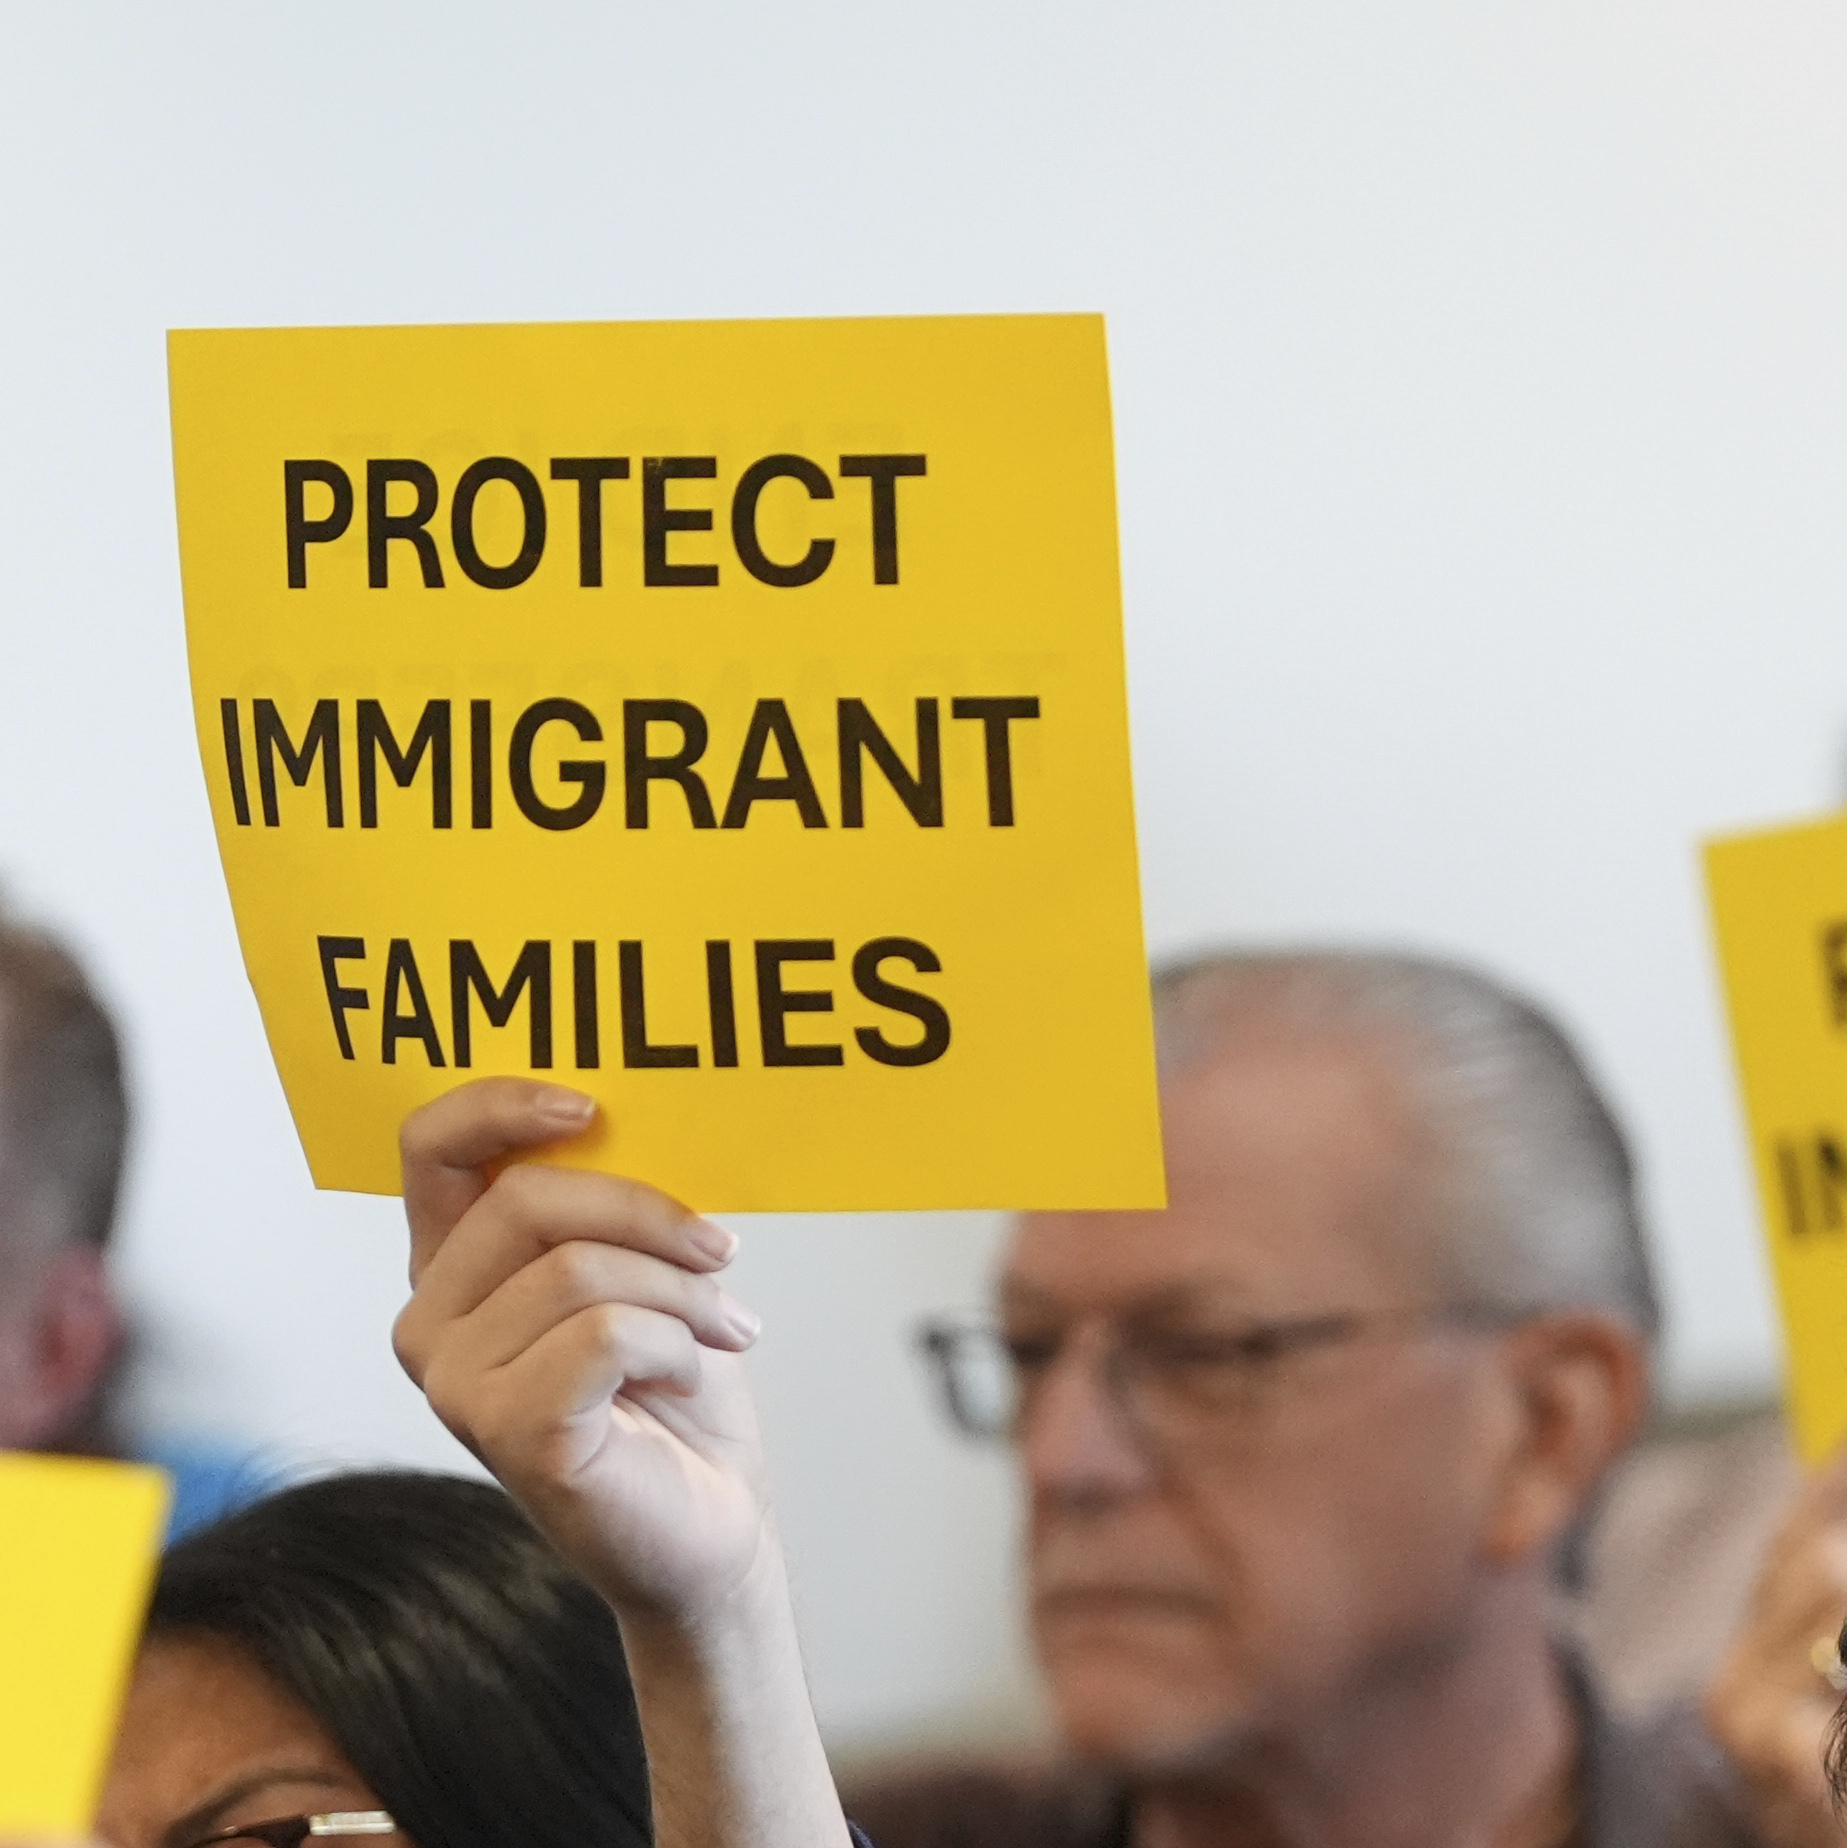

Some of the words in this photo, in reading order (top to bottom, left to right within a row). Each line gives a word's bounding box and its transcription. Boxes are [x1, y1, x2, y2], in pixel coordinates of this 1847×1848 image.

[282, 453, 928, 591] PROTECT
[219, 696, 1042, 832] IMMIGRANT
[316, 935, 953, 1070] FAMILIES
